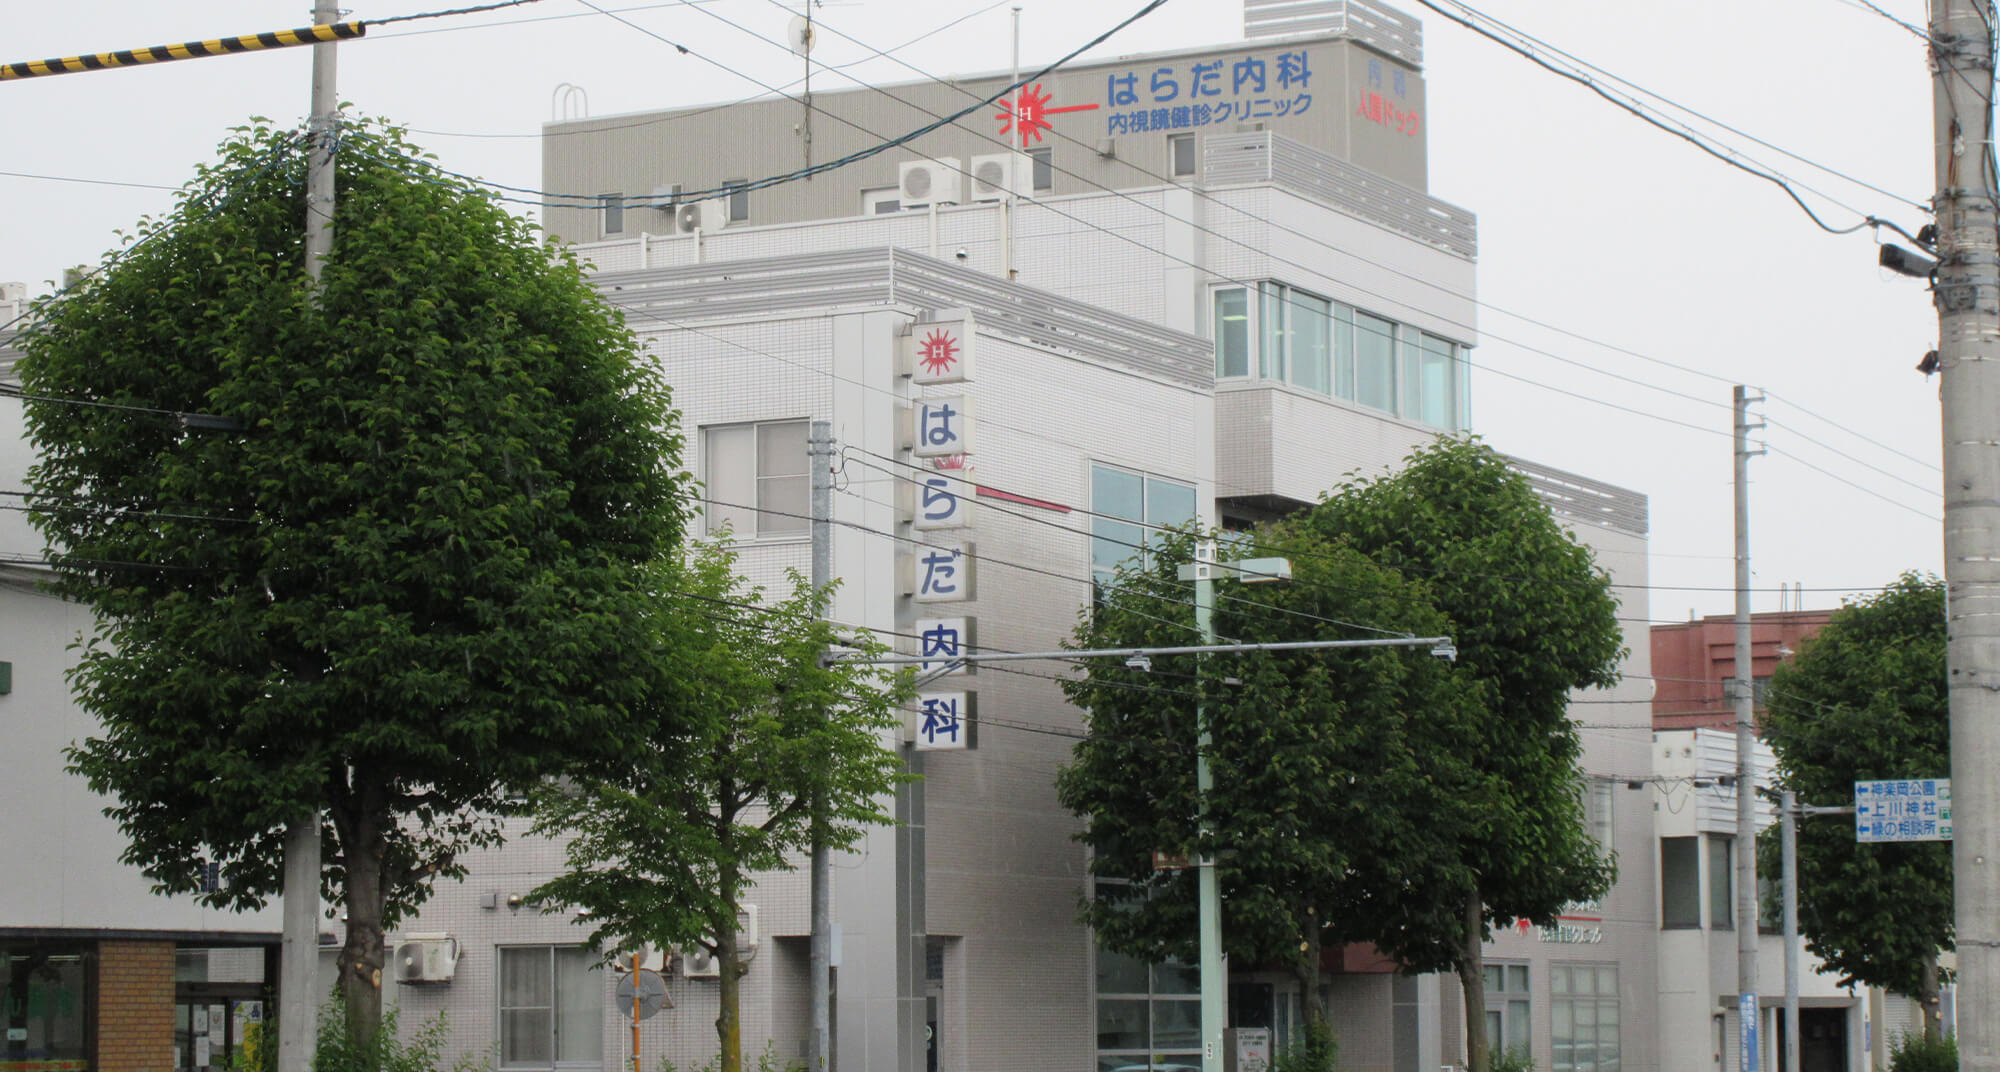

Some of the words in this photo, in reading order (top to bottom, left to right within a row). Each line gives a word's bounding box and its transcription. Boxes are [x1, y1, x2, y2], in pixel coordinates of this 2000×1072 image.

[1108, 51, 1312, 107] はらだ内科
[1108, 93, 1312, 135] 内視鏡健診クリニック
[1356, 87, 1419, 136] 人間ドック
[932, 344, 945, 358] H
[921, 403, 960, 743] はらだ内科
[1872, 781, 1936, 797] 神楽岡公園
[1872, 800, 1936, 816] 上川神社
[1872, 819, 1936, 836] 緑の相談所
